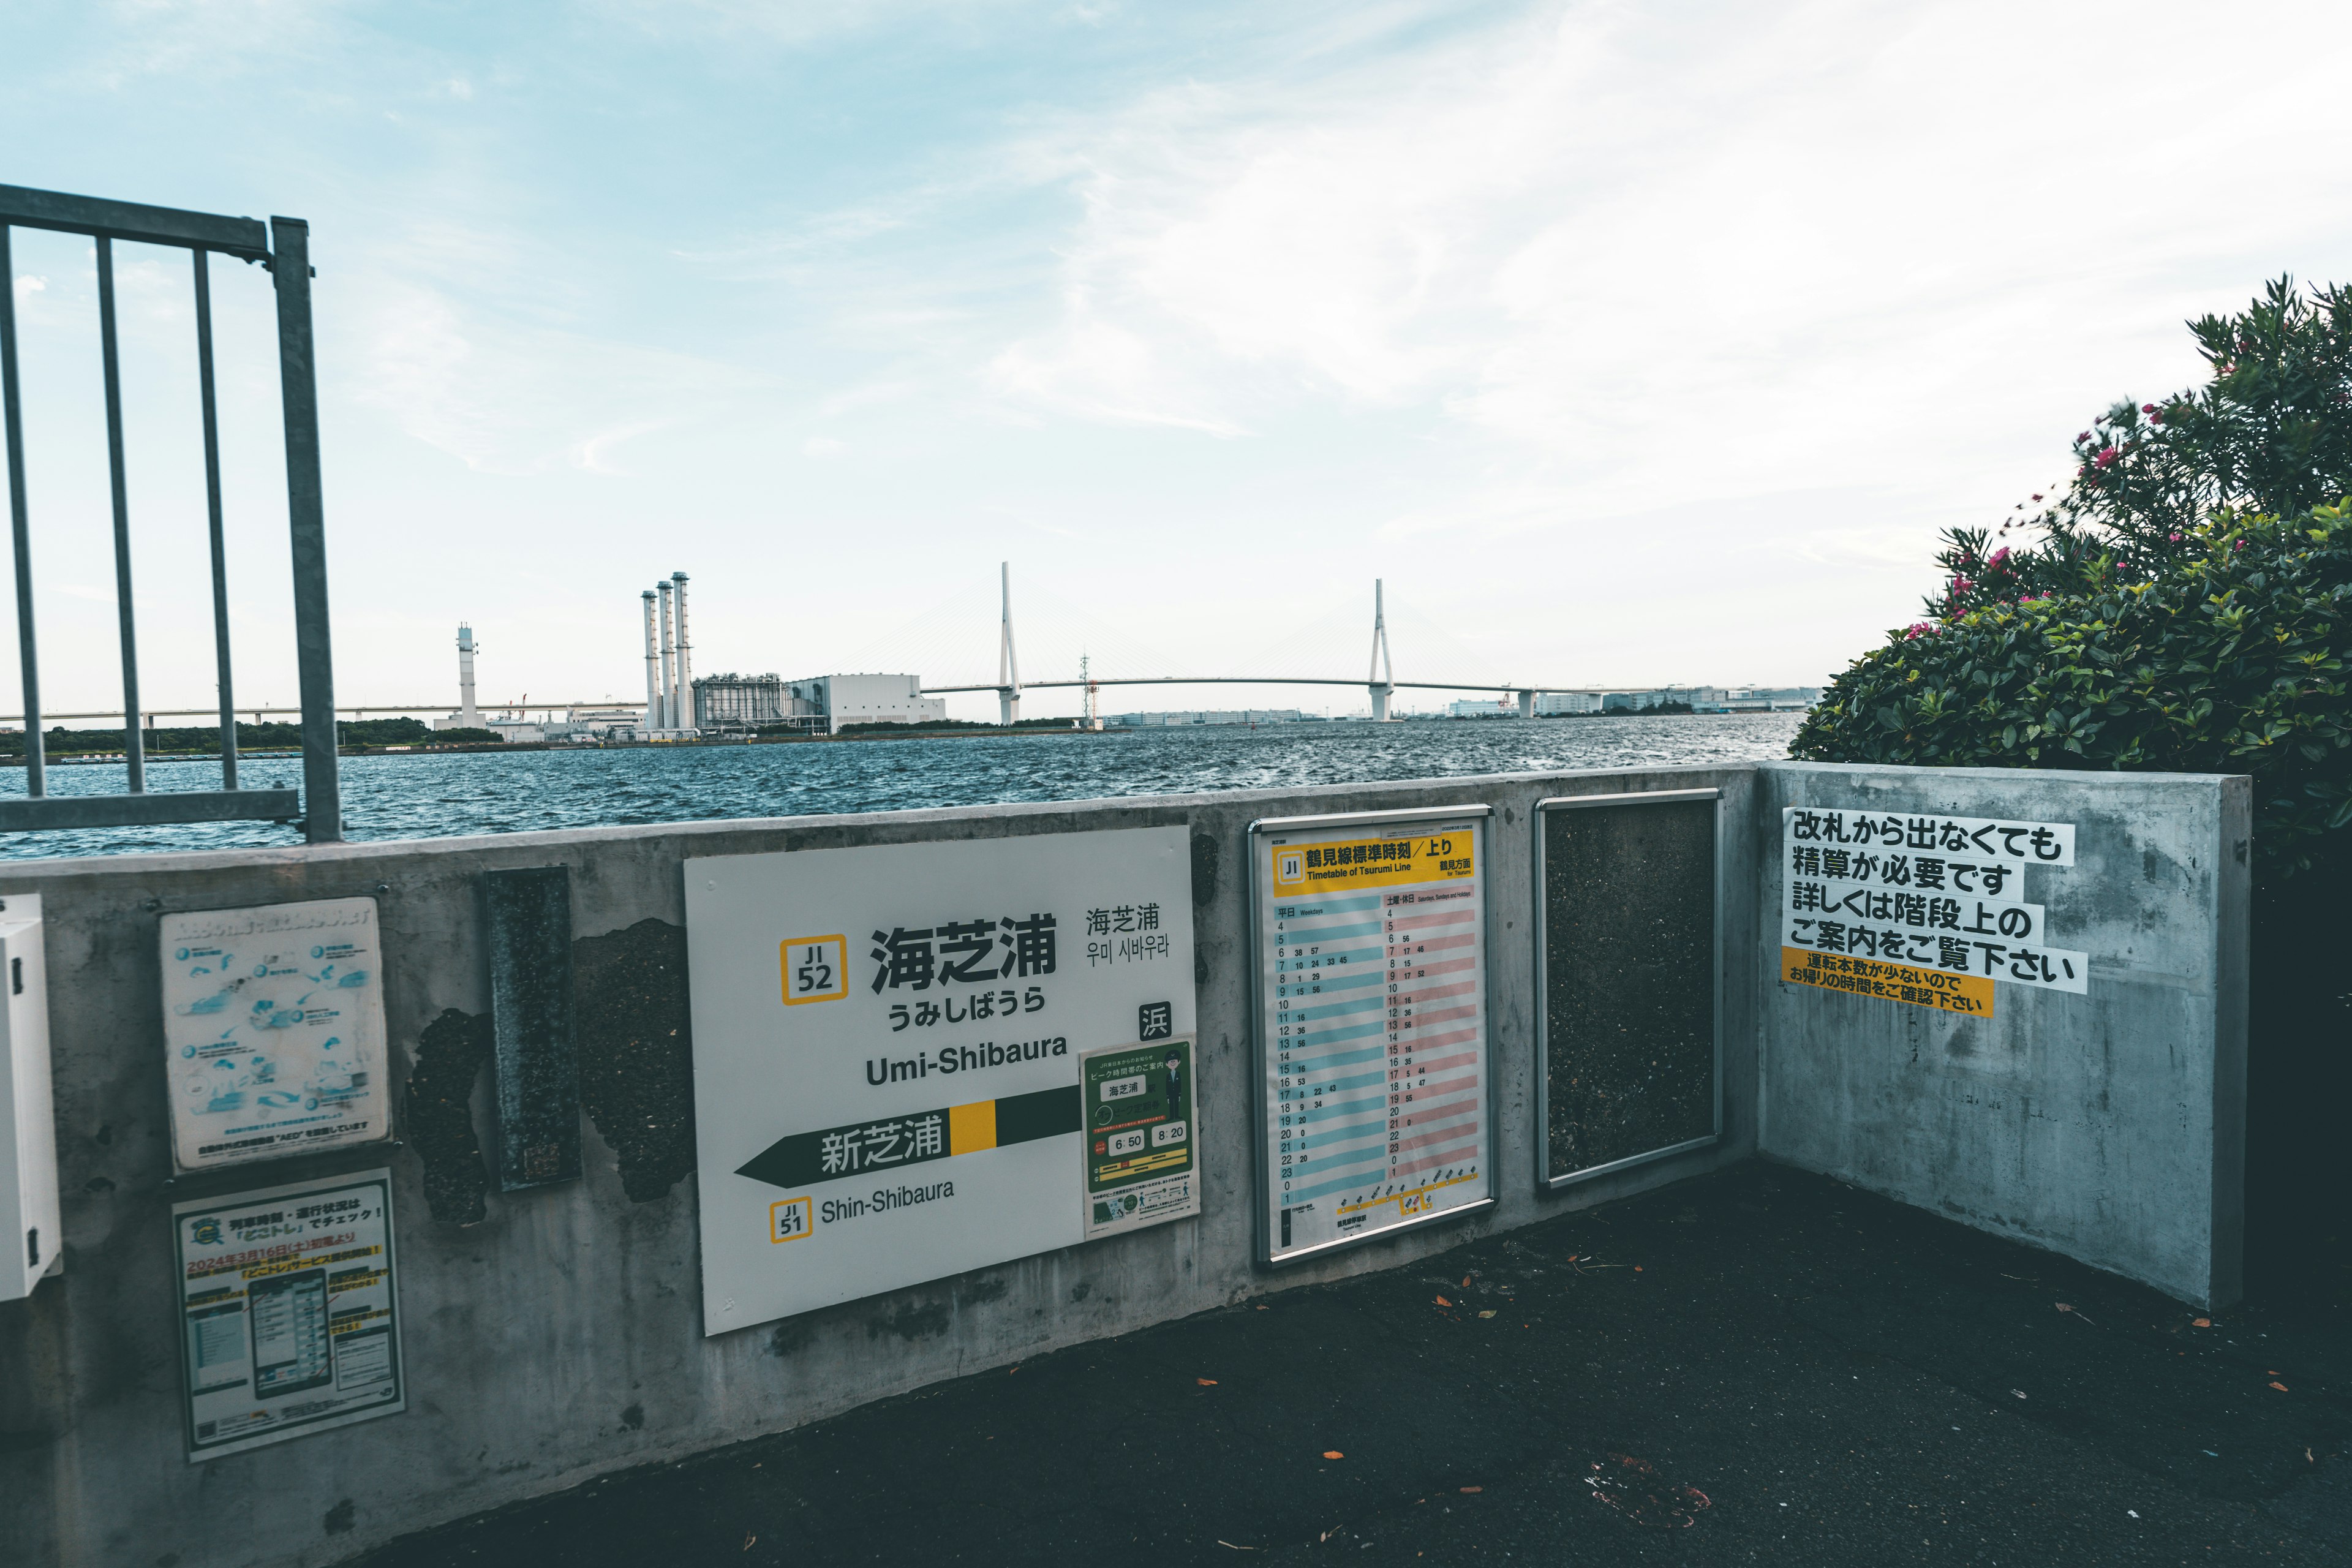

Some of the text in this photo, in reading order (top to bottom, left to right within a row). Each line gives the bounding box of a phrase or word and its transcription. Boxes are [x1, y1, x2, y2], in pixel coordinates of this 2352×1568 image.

[1793, 811, 2062, 861] 改札から出なくても
[1286, 861, 1297, 875] JI
[1439, 859, 1471, 870] 鶴見方面
[1308, 863, 1411, 880] Timetable of Tsurumi Line
[1793, 845, 2012, 895] 精算が必要です
[1387, 894, 1414, 906] 土曜・休日
[1418, 894, 1434, 903] Saturdays,
[1278, 908, 1295, 918] 平日
[1388, 909, 1392, 918] 4
[1792, 881, 2032, 939] 詳しくは階段上の
[1086, 903, 1159, 937] 海芝浦
[1278, 922, 1283, 930] 4
[1388, 922, 1393, 930] 5
[1279, 935, 1284, 944] 5
[1389, 934, 1393, 943] 6
[804, 946, 822, 964] JI
[870, 913, 1057, 995] 海芝浦
[1087, 934, 1169, 968] 우미 시바우라
[1279, 948, 1284, 957] 6
[1390, 947, 1394, 956] 7
[1790, 919, 2075, 982] ご案内をご覧下さい
[1280, 962, 1284, 970] 7
[1390, 959, 1395, 968] 8
[1390, 971, 1395, 980] 9
[1806, 952, 1961, 992] 運転本数が少ないので
[798, 965, 833, 991] 52
[1280, 974, 1285, 983] 8
[1280, 987, 1286, 997] 9
[1389, 984, 1397, 993] 10
[1790, 967, 1982, 1012] お帰りの時間をご確認下さい
[1279, 1000, 1289, 1009] 10
[1389, 996, 1396, 1005] 11
[888, 987, 1046, 1032] うみしばうら
[1389, 1008, 1397, 1017] 12
[1142, 1007, 1168, 1036] 浜
[1280, 1013, 1289, 1023] 11
[1389, 1020, 1398, 1030] 13
[1280, 1026, 1289, 1036] 12
[1389, 1033, 1398, 1042] 14
[1280, 1039, 1290, 1049] 13
[1389, 1045, 1398, 1055] 15
[866, 1035, 1068, 1086] Umi-Shibaura
[1100, 1055, 1153, 1068] JR東日本からのお知らせ
[1280, 1052, 1290, 1061] 14
[1390, 1058, 1398, 1067] 16
[1280, 1065, 1290, 1074] 15
[1390, 1070, 1398, 1079] 17
[1281, 1077, 1290, 1087] 16
[1390, 1082, 1398, 1091] 18
[1109, 1082, 1138, 1097] 海芝浦
[1281, 1090, 1290, 1100] 17
[1390, 1095, 1399, 1104] 19
[1281, 1103, 1290, 1113] 18
[1390, 1107, 1399, 1117] 20
[1281, 1116, 1291, 1126] 19
[1390, 1119, 1399, 1129] 21
[1281, 1129, 1291, 1139] 20
[1390, 1131, 1399, 1141] 22
[821, 1115, 943, 1174] 新芝浦
[1281, 1142, 1291, 1152] 21
[1390, 1144, 1399, 1153] 23
[1282, 1155, 1292, 1165] 22
[1392, 1156, 1396, 1164] 0
[1281, 1168, 1291, 1178] 23
[1392, 1169, 1396, 1177] 1
[1284, 1181, 1290, 1190] 0
[821, 1178, 954, 1223] Shin-Shibaura
[1286, 1194, 1289, 1203] 1
[785, 1205, 797, 1218] JI
[780, 1215, 801, 1235] 51
